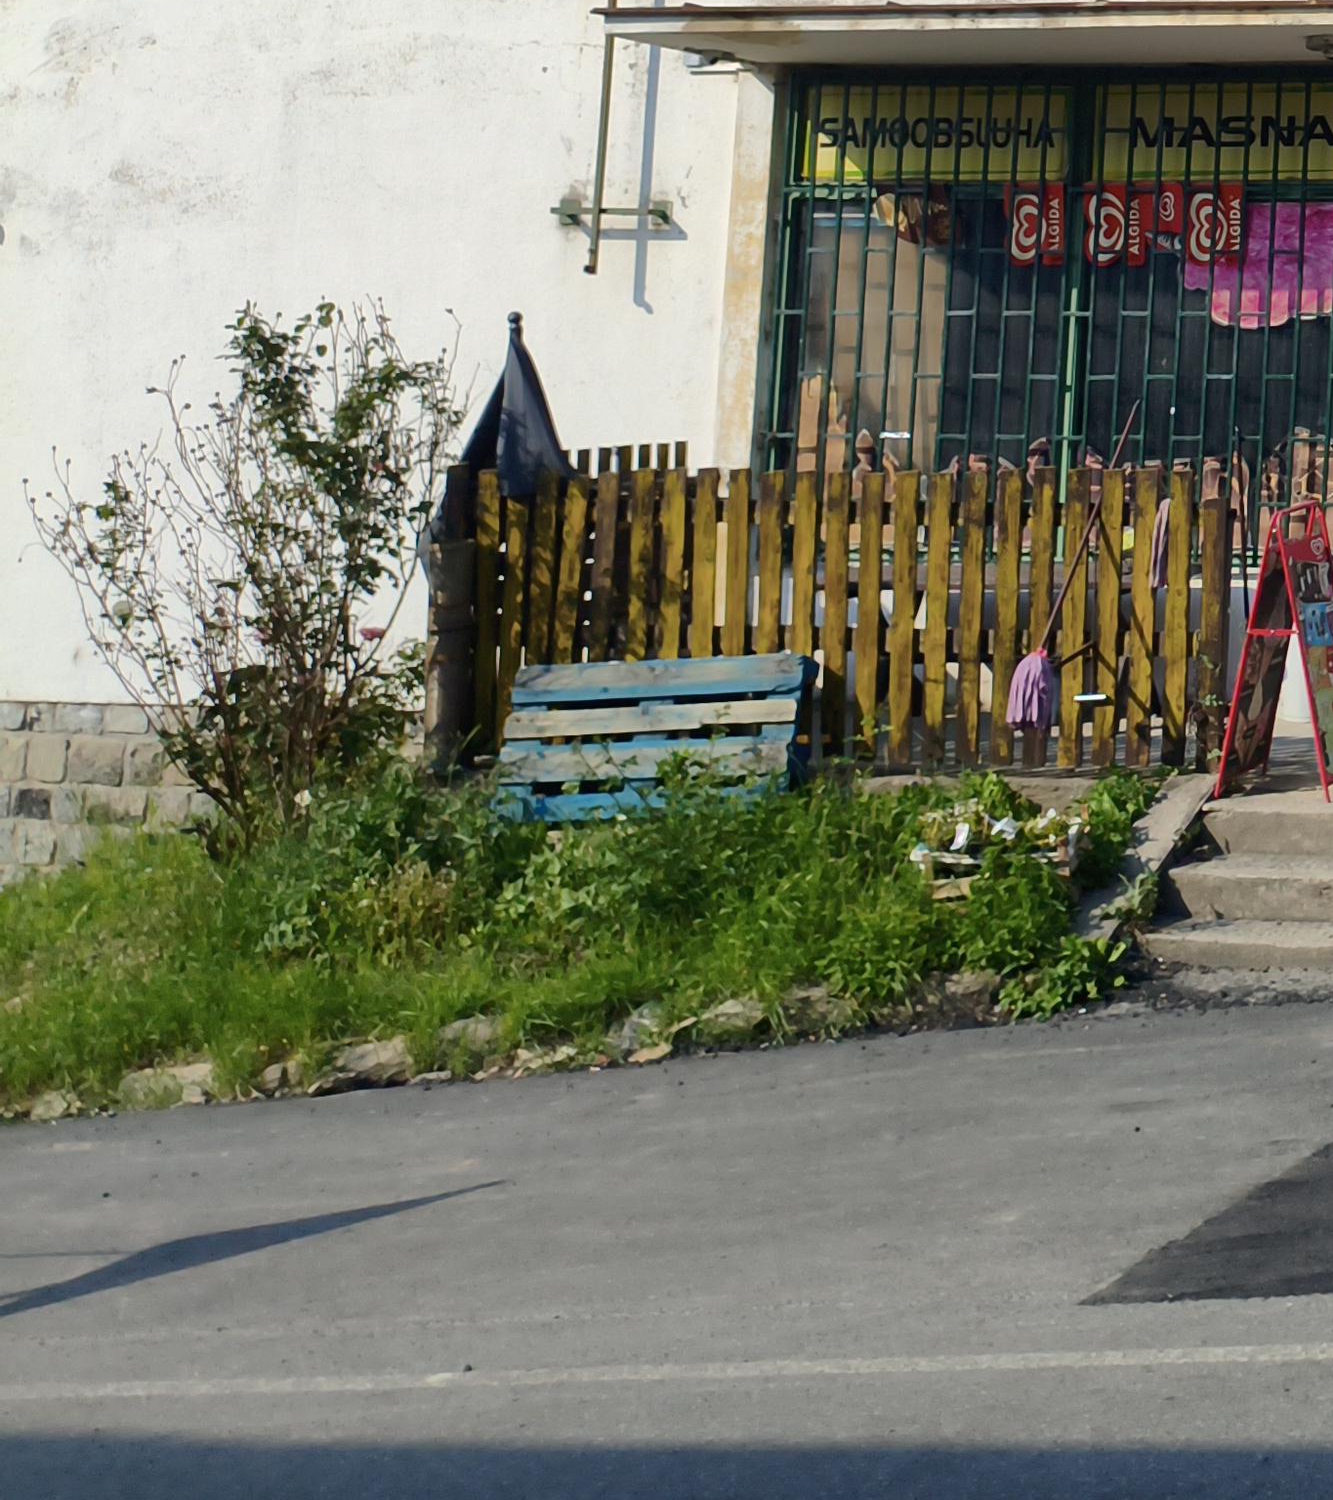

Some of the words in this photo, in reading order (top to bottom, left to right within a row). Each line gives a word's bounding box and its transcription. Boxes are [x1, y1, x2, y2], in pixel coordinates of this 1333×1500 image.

[1048, 198, 1060, 252] ALGIDA
[1128, 199, 1140, 255] ALGIDA
[1229, 198, 1241, 252] ALGIDA
